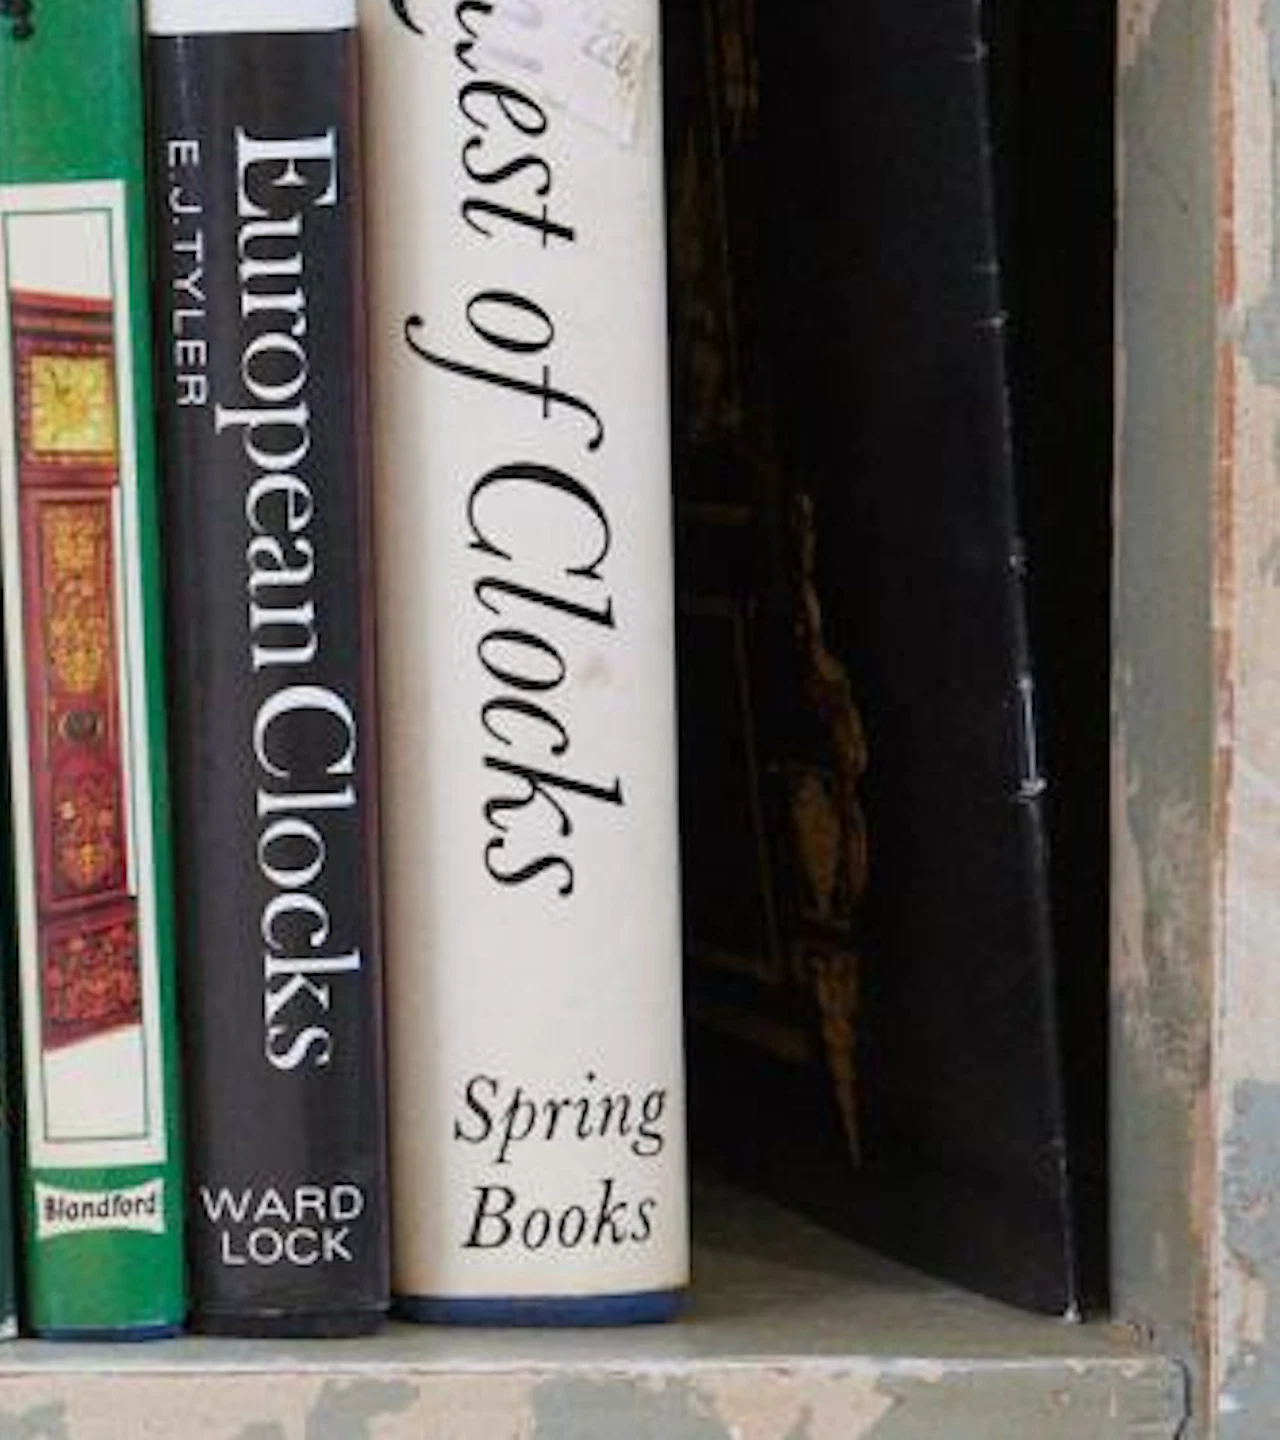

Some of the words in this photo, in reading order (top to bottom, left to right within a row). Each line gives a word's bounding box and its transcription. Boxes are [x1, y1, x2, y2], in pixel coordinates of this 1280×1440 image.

[215, 126, 340, 672] European
[404, 290, 605, 453] of
[467, 462, 625, 897] Clocks
[253, 684, 361, 1071] Clocks
[455, 1070, 667, 1164] Spring
[44, 1192, 157, 1223] Blandford
[201, 1184, 364, 1223] WARD
[222, 1226, 353, 1266] LOCK
[461, 1178, 657, 1252] Books
